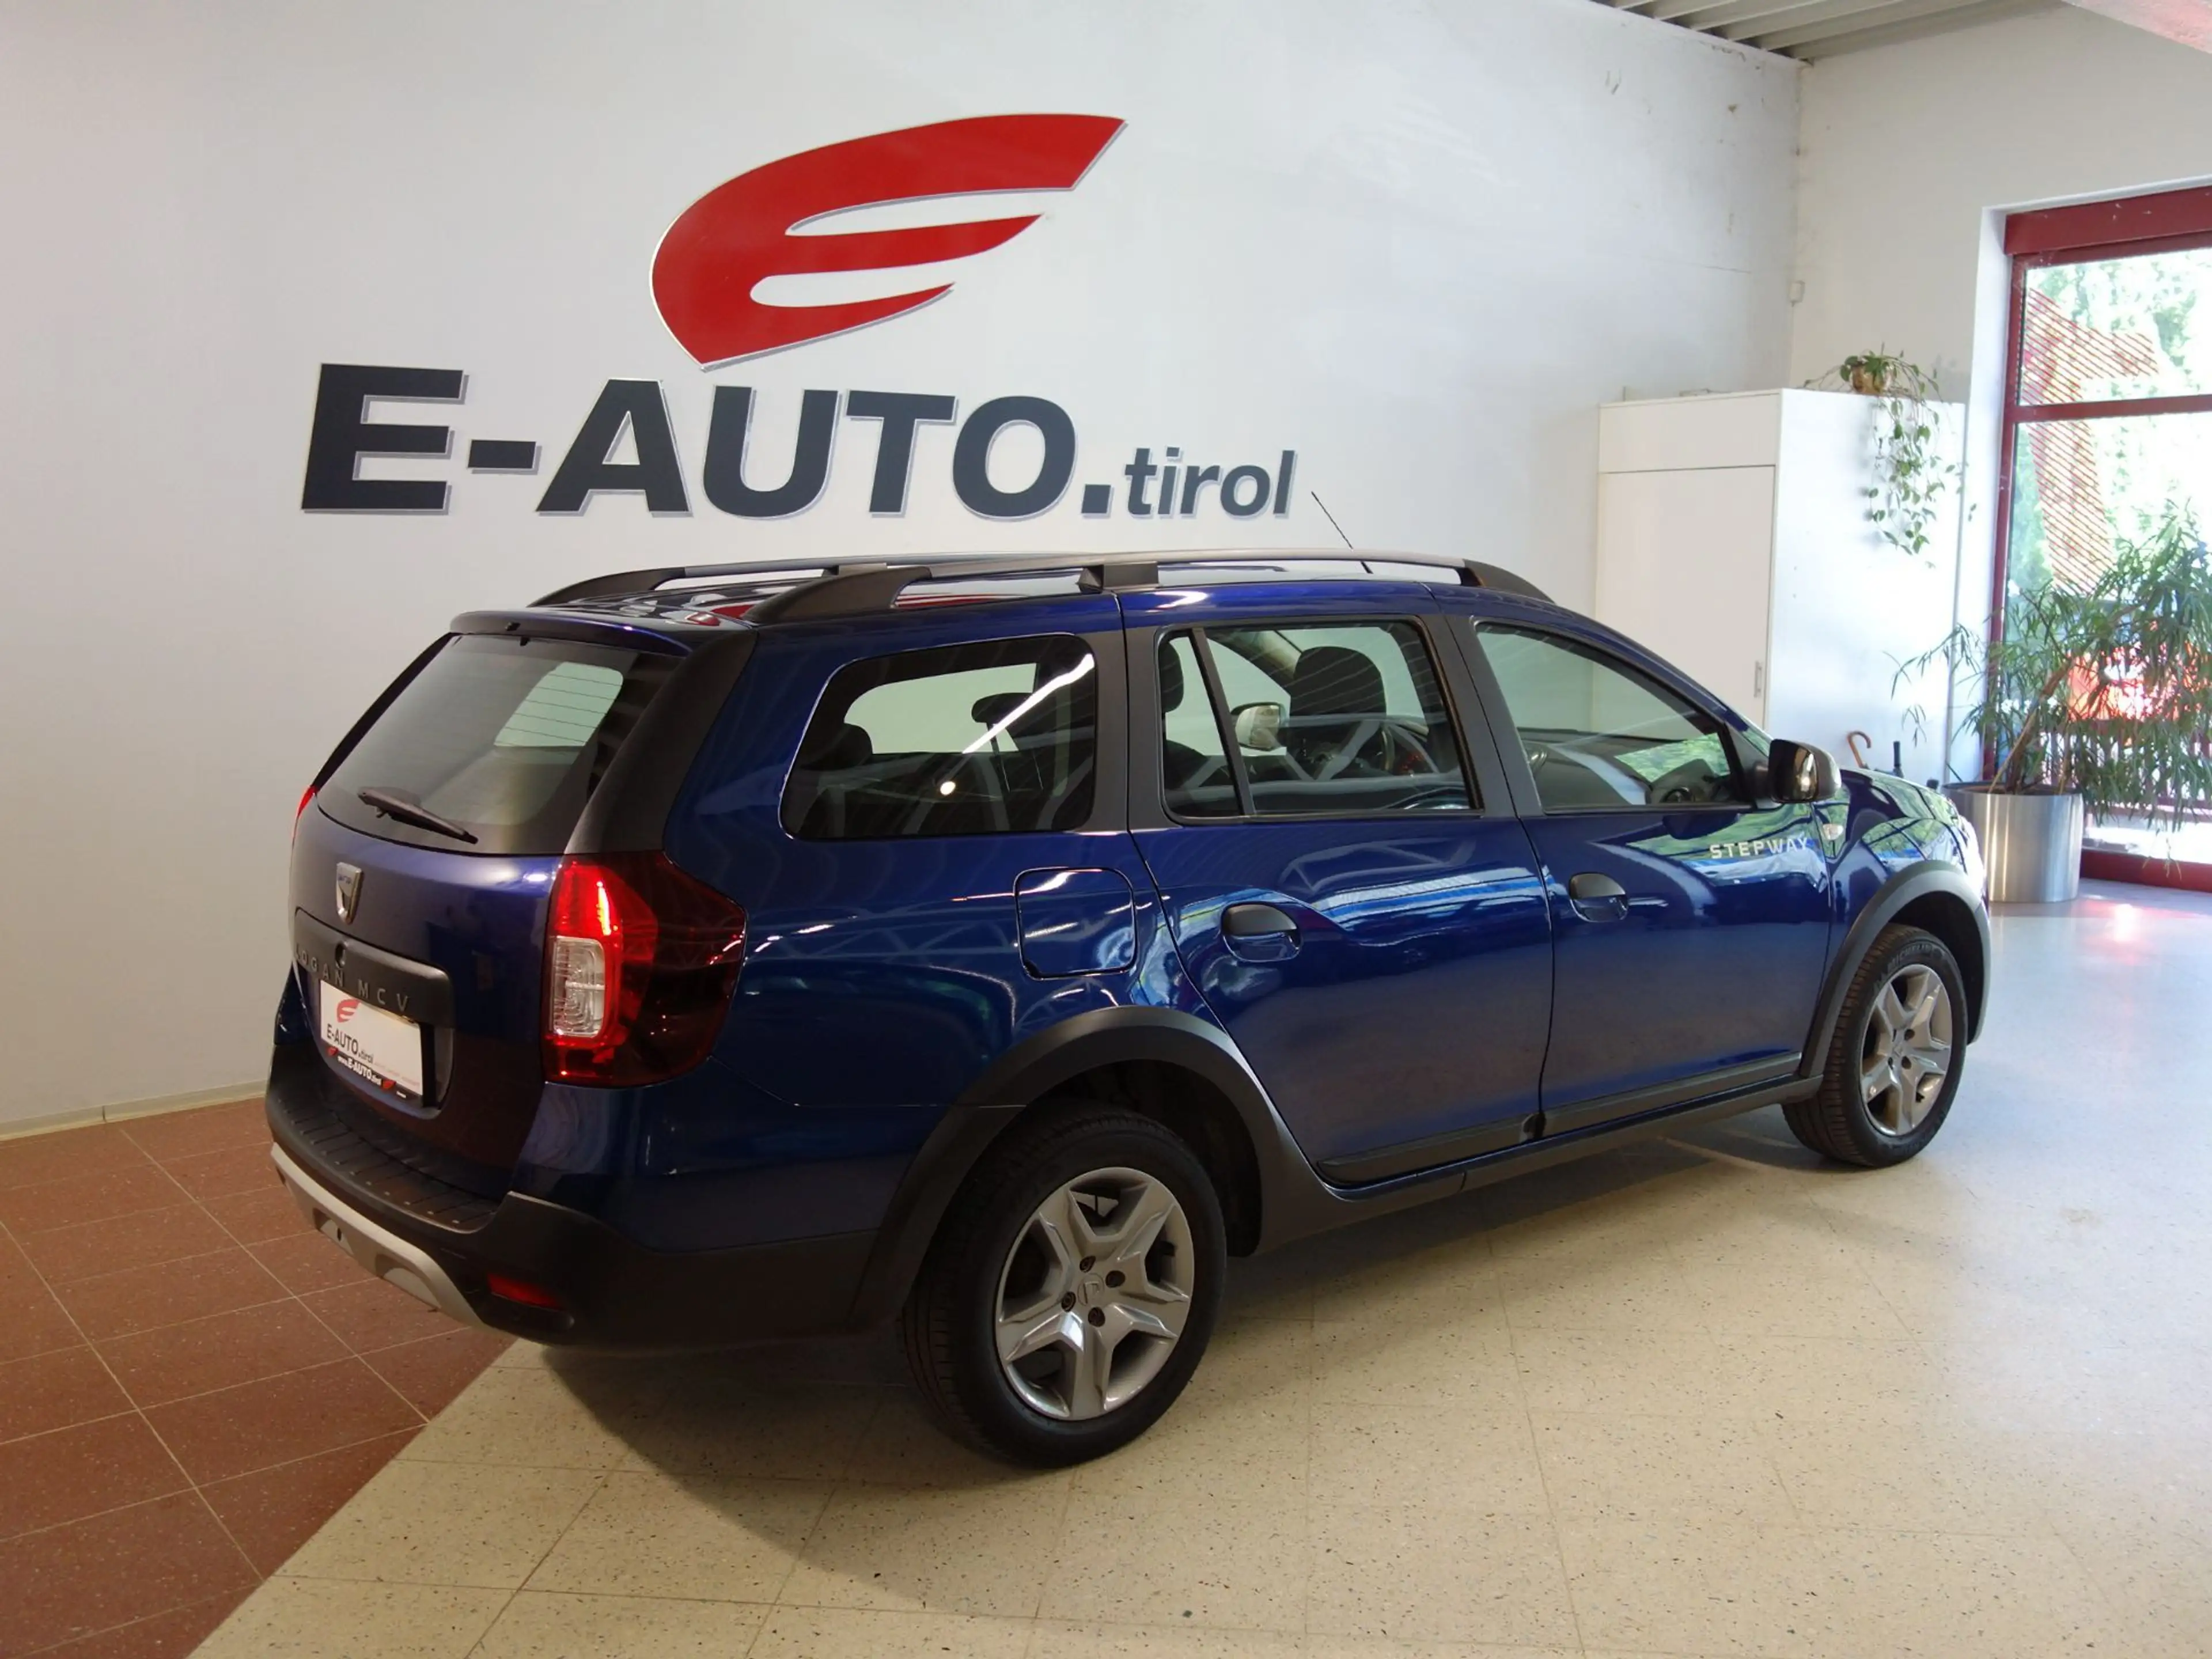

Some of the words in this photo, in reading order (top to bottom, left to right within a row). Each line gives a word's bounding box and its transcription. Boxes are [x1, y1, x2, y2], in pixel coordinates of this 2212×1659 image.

[302, 363, 1294, 517] E-AUTO.tirol
[1709, 836, 1808, 859] STEPWAY
[296, 944, 344, 987] LOGAN
[358, 979, 410, 1012] MCV
